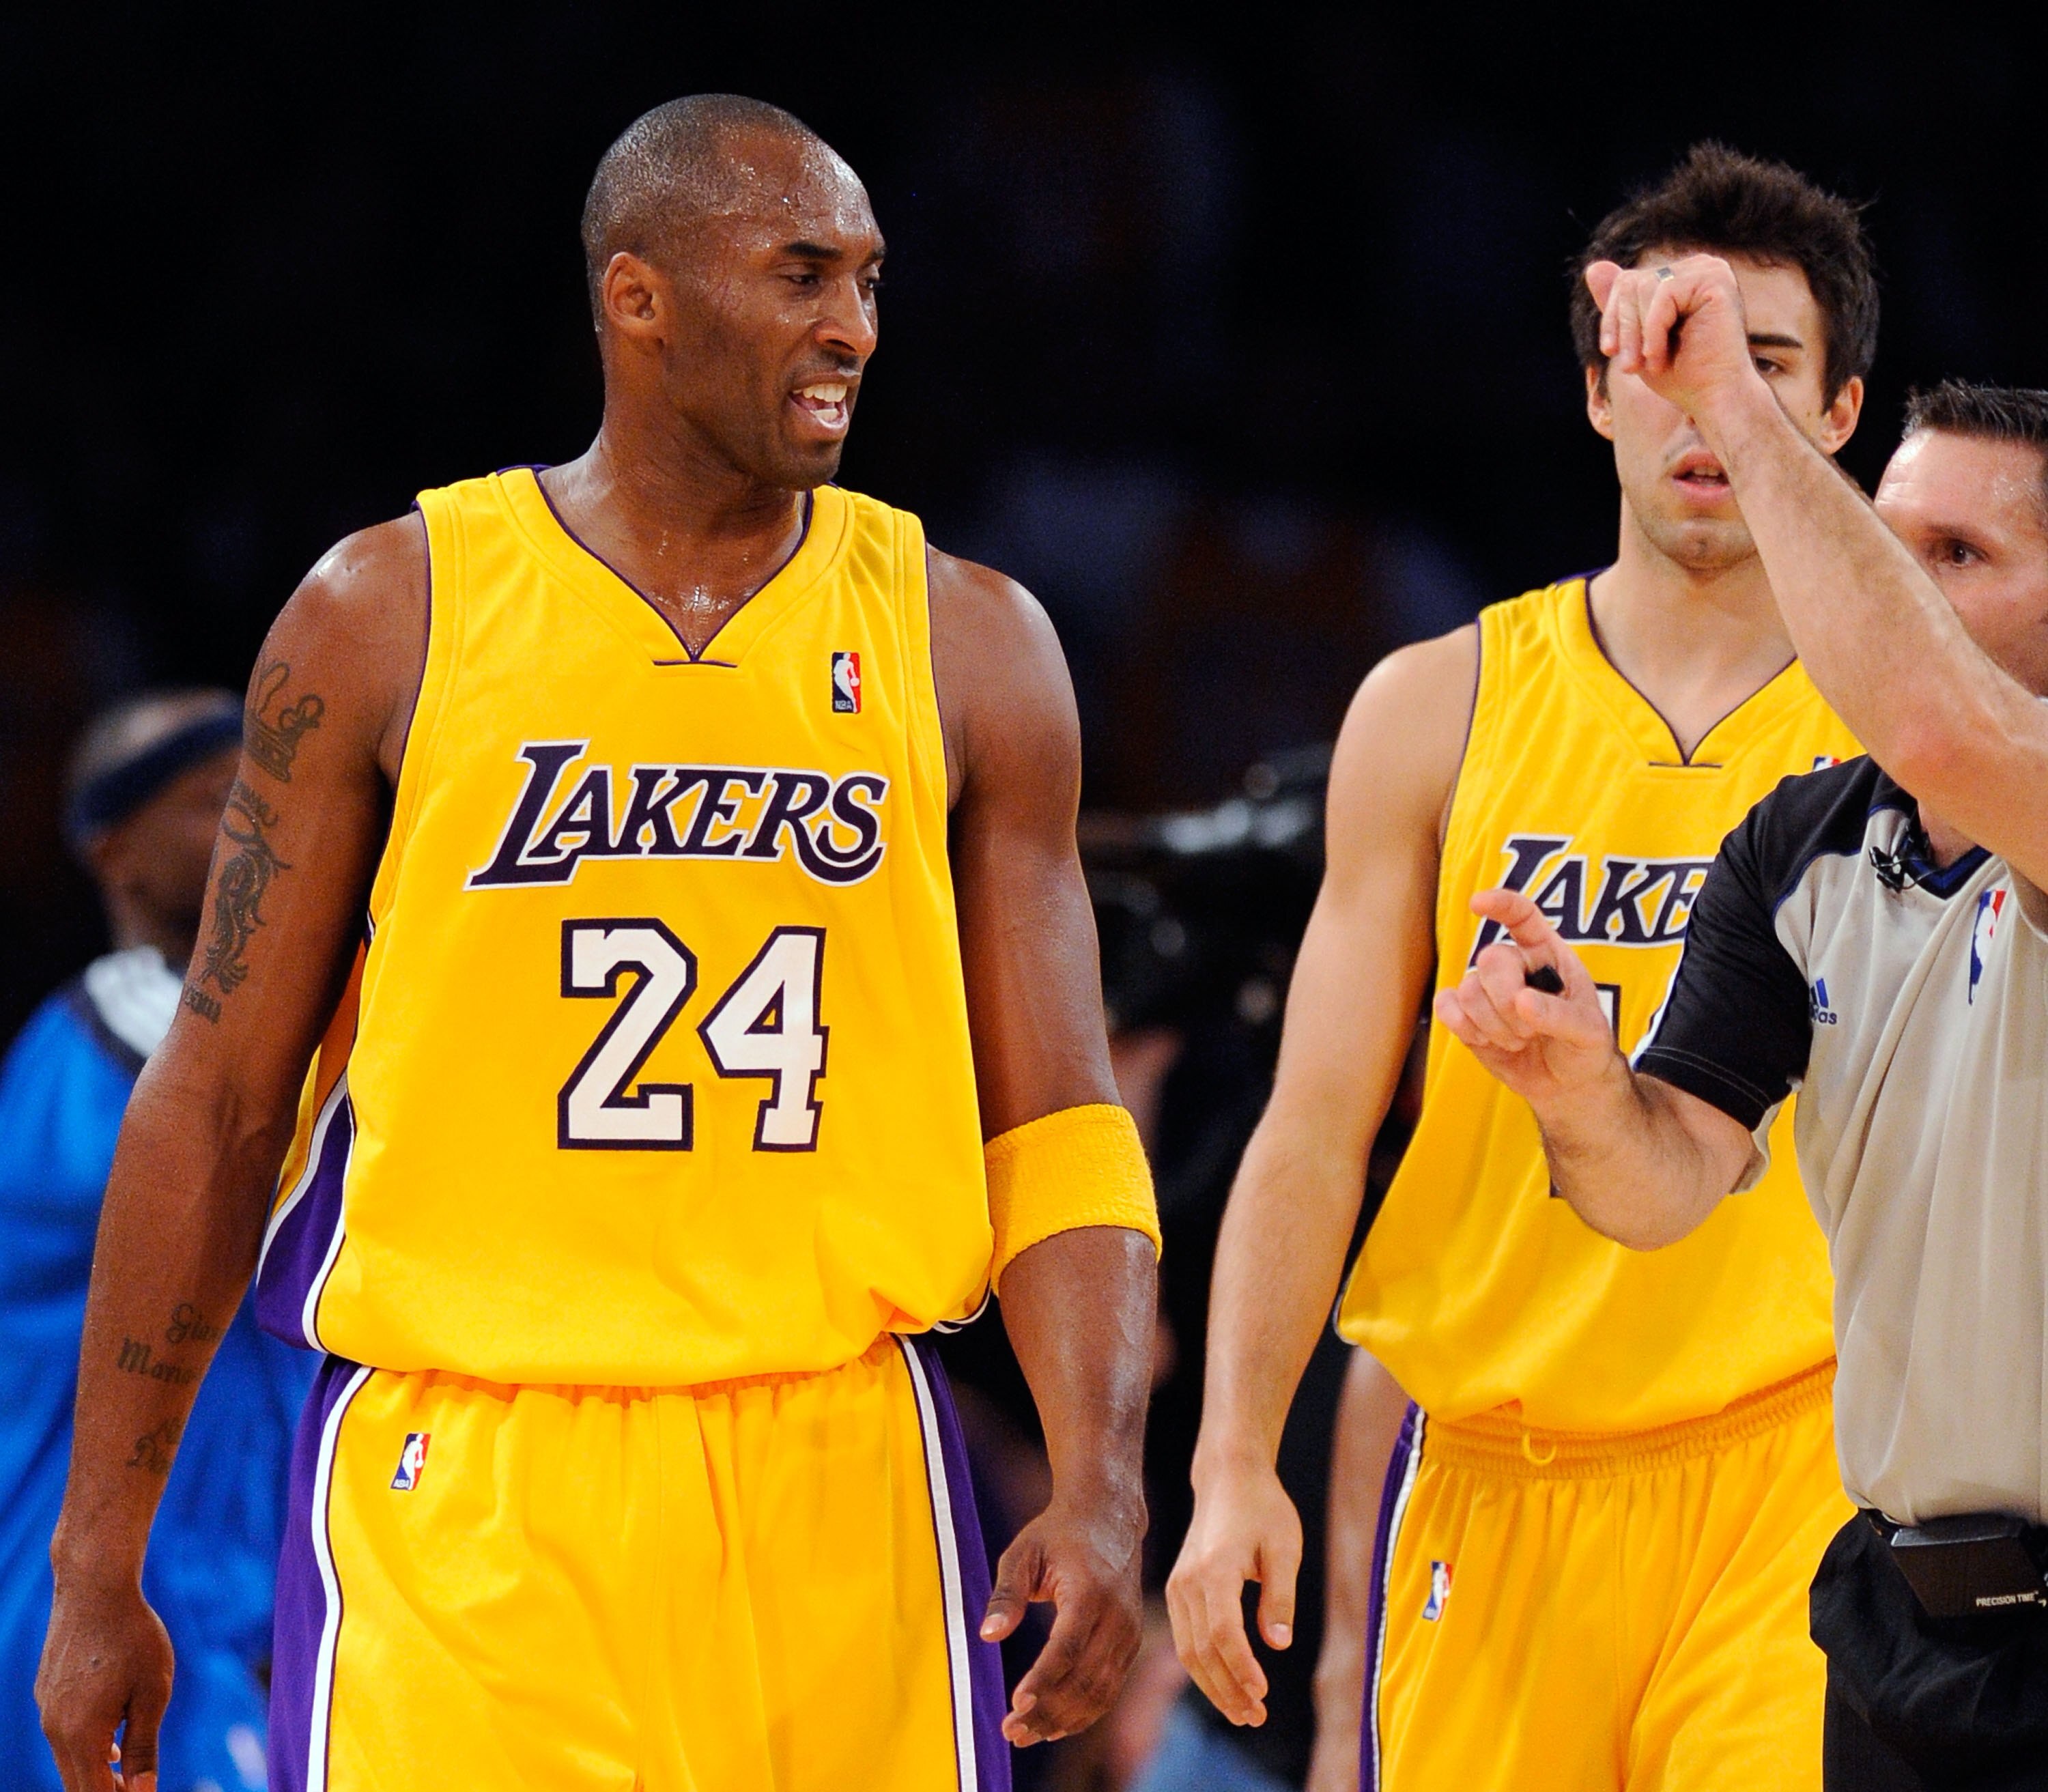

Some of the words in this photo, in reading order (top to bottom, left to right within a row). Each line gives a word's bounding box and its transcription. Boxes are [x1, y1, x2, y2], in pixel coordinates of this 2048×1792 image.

[463, 739, 890, 892] LAKERS
[1466, 834, 1716, 972] LAKE
[557, 918, 830, 1152] 24
[1976, 1595, 2016, 1606] PRECISION
